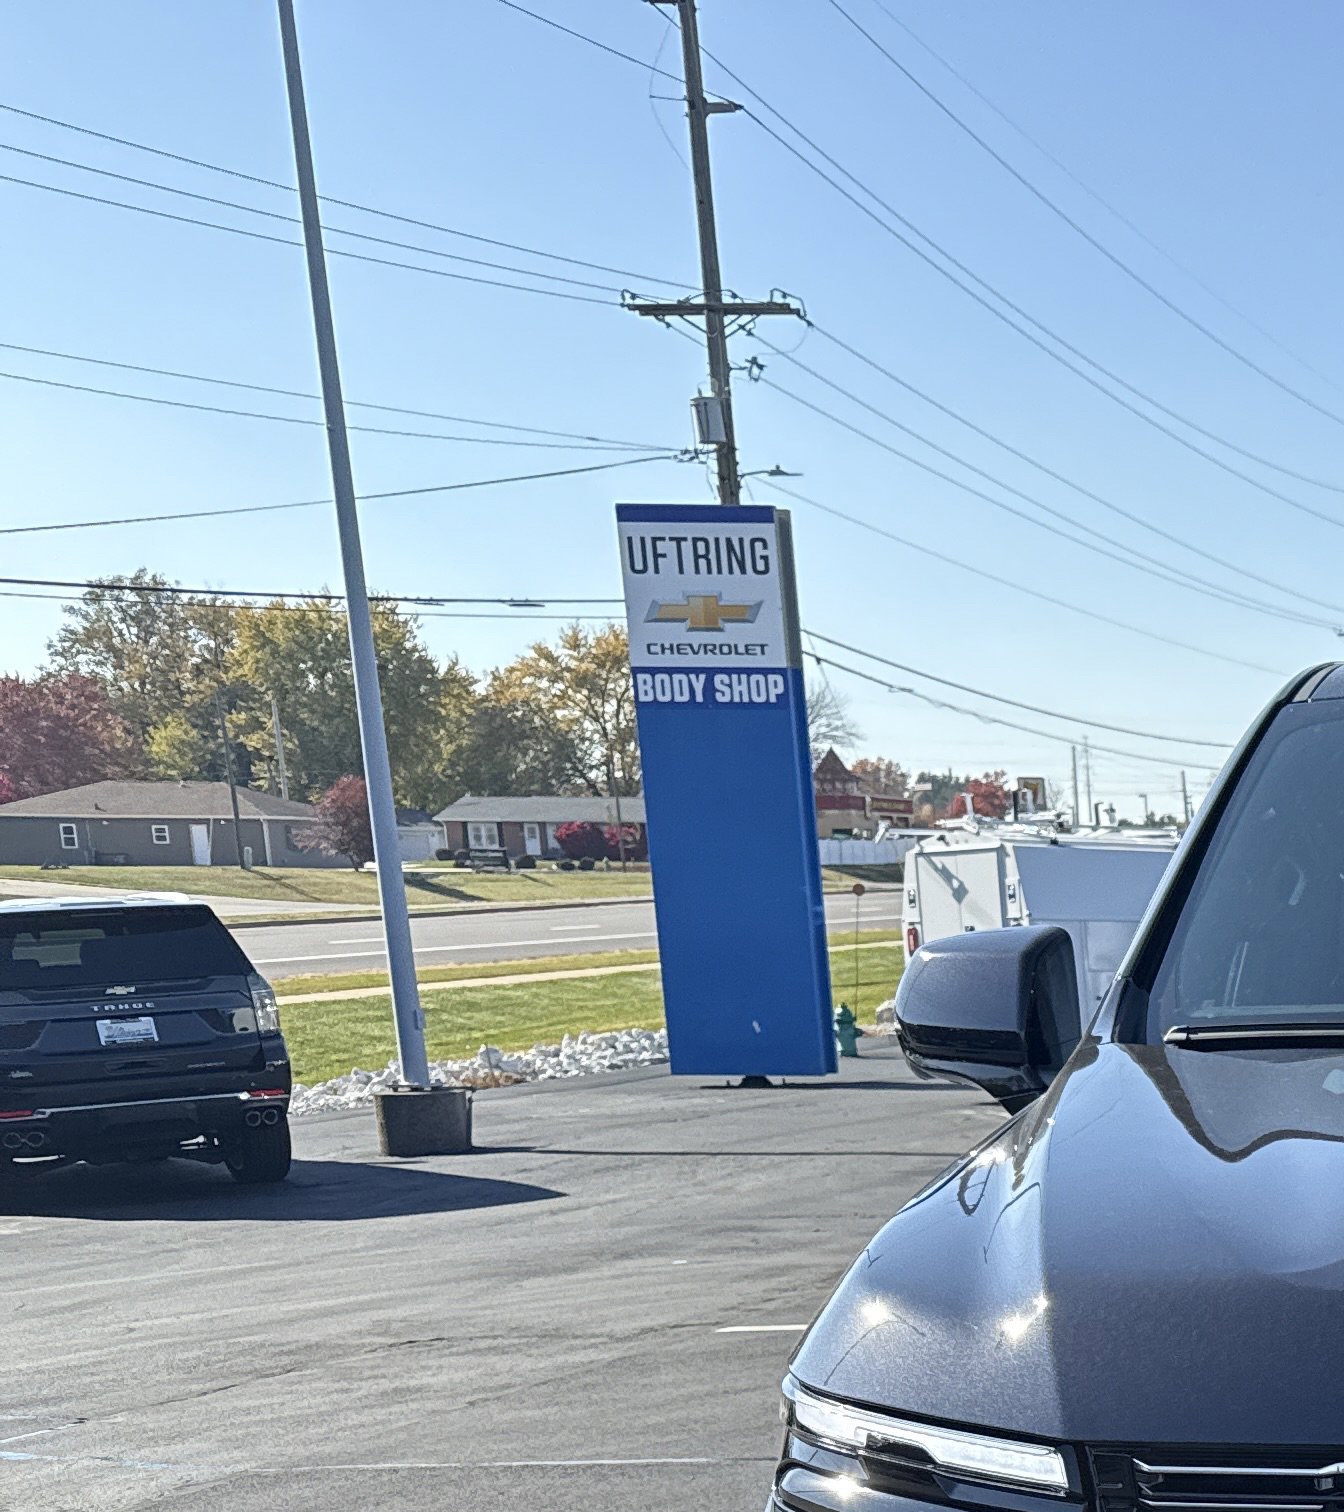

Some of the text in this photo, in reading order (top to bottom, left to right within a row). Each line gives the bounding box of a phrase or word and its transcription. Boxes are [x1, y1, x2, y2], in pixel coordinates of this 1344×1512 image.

[626, 536, 770, 575] UFTRING
[646, 642, 769, 656] CHEVROLET
[636, 672, 785, 704] BODY SHOP
[90, 1002, 155, 1012] TAHOE
